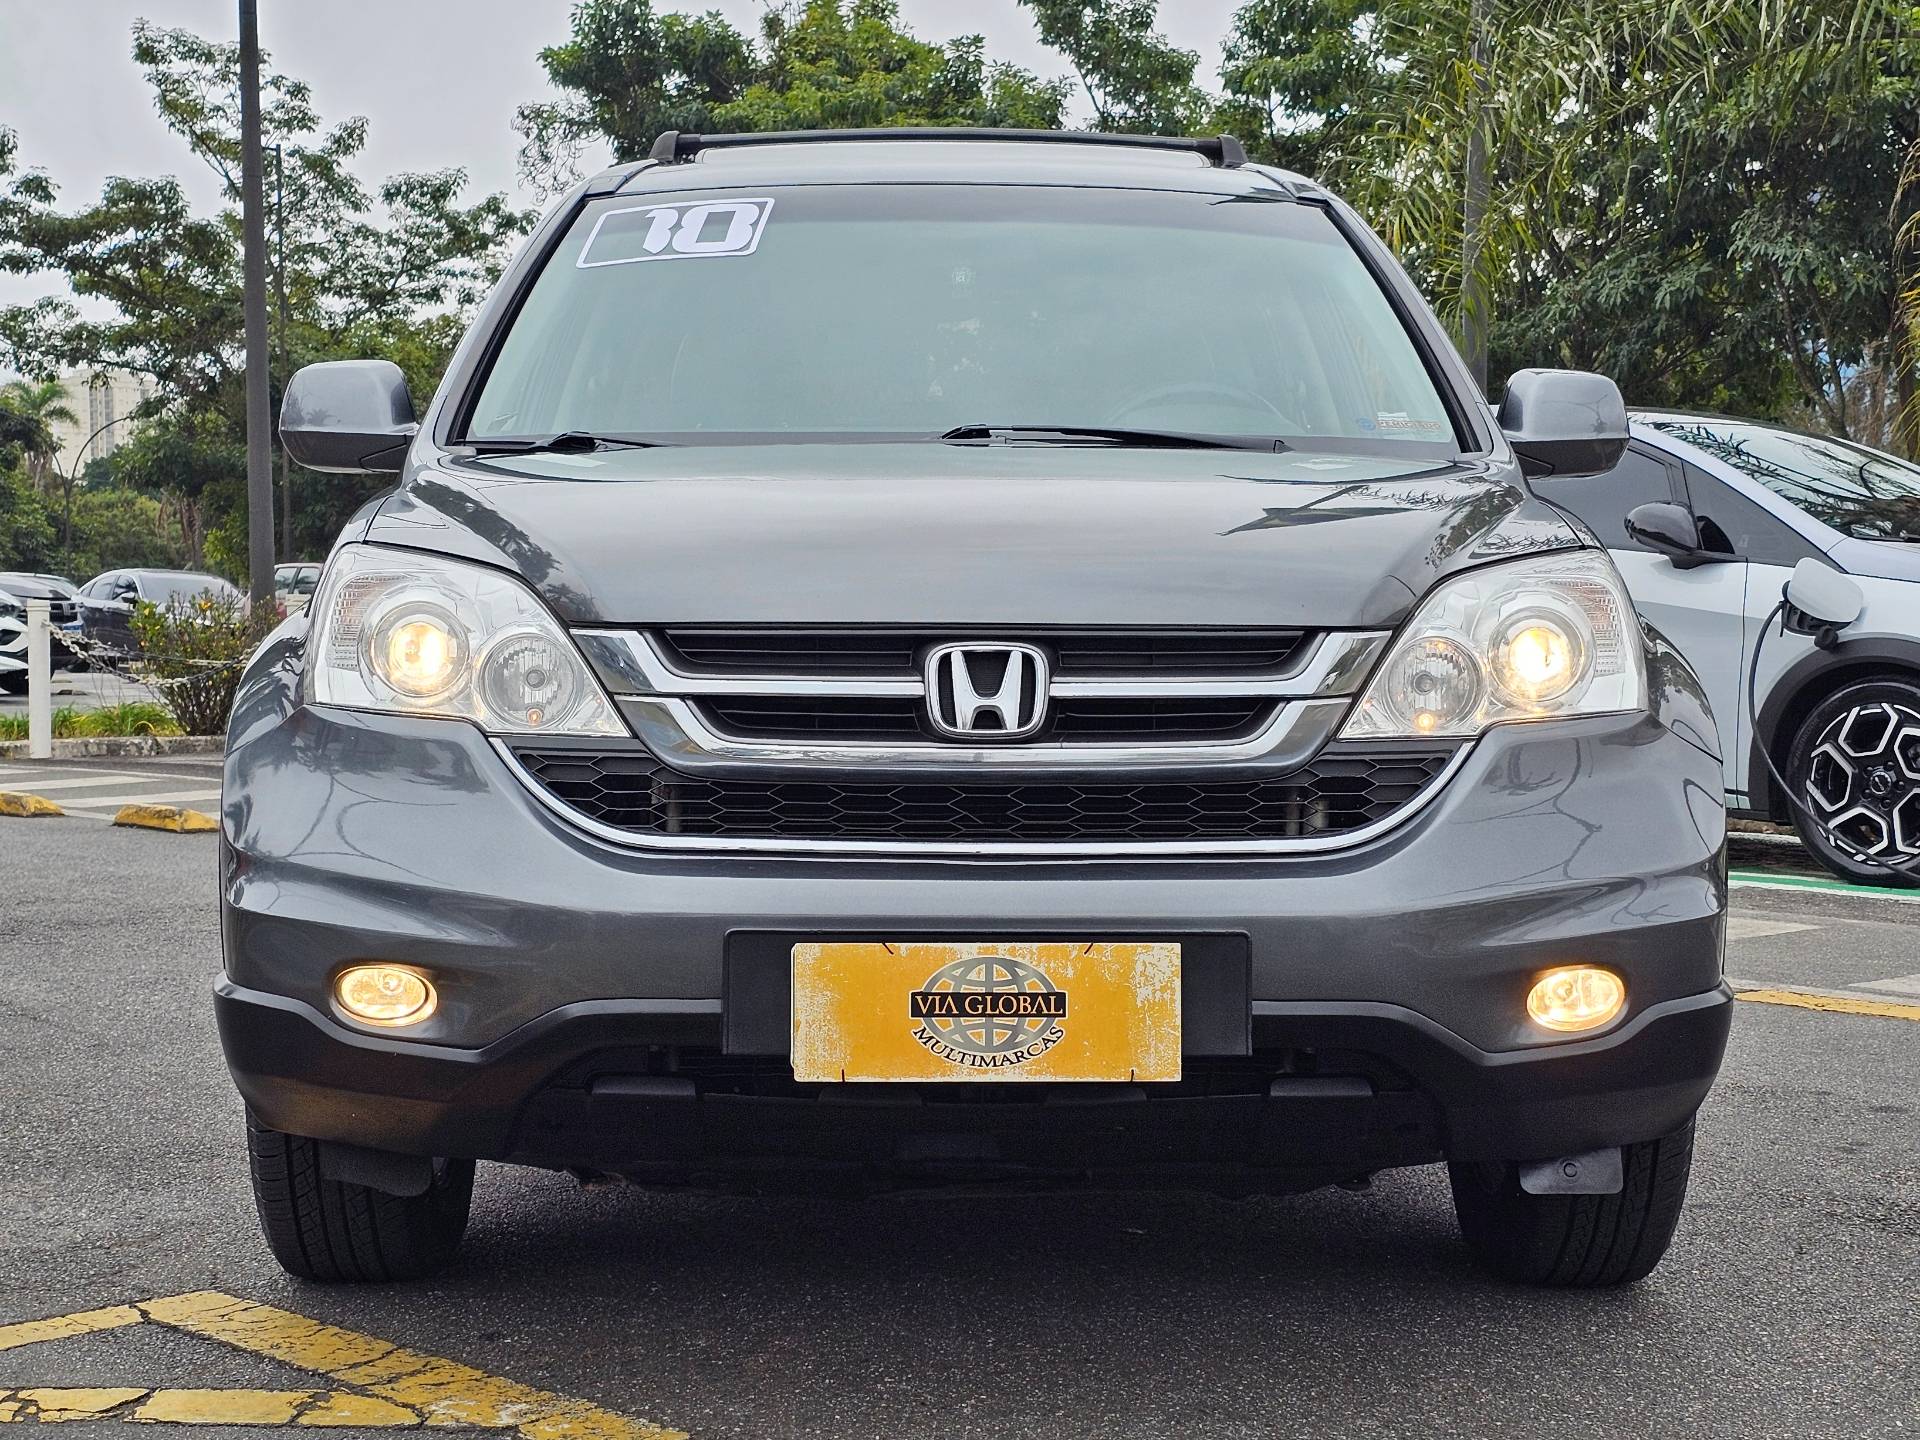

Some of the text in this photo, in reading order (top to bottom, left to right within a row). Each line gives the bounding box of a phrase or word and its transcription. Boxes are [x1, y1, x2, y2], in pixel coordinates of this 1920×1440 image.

[642, 203, 760, 254] 10
[950, 649, 1023, 731] H
[914, 995, 1064, 1015] VIA GLOBAL
[912, 1026, 1065, 1068] MULTIMARCAS
